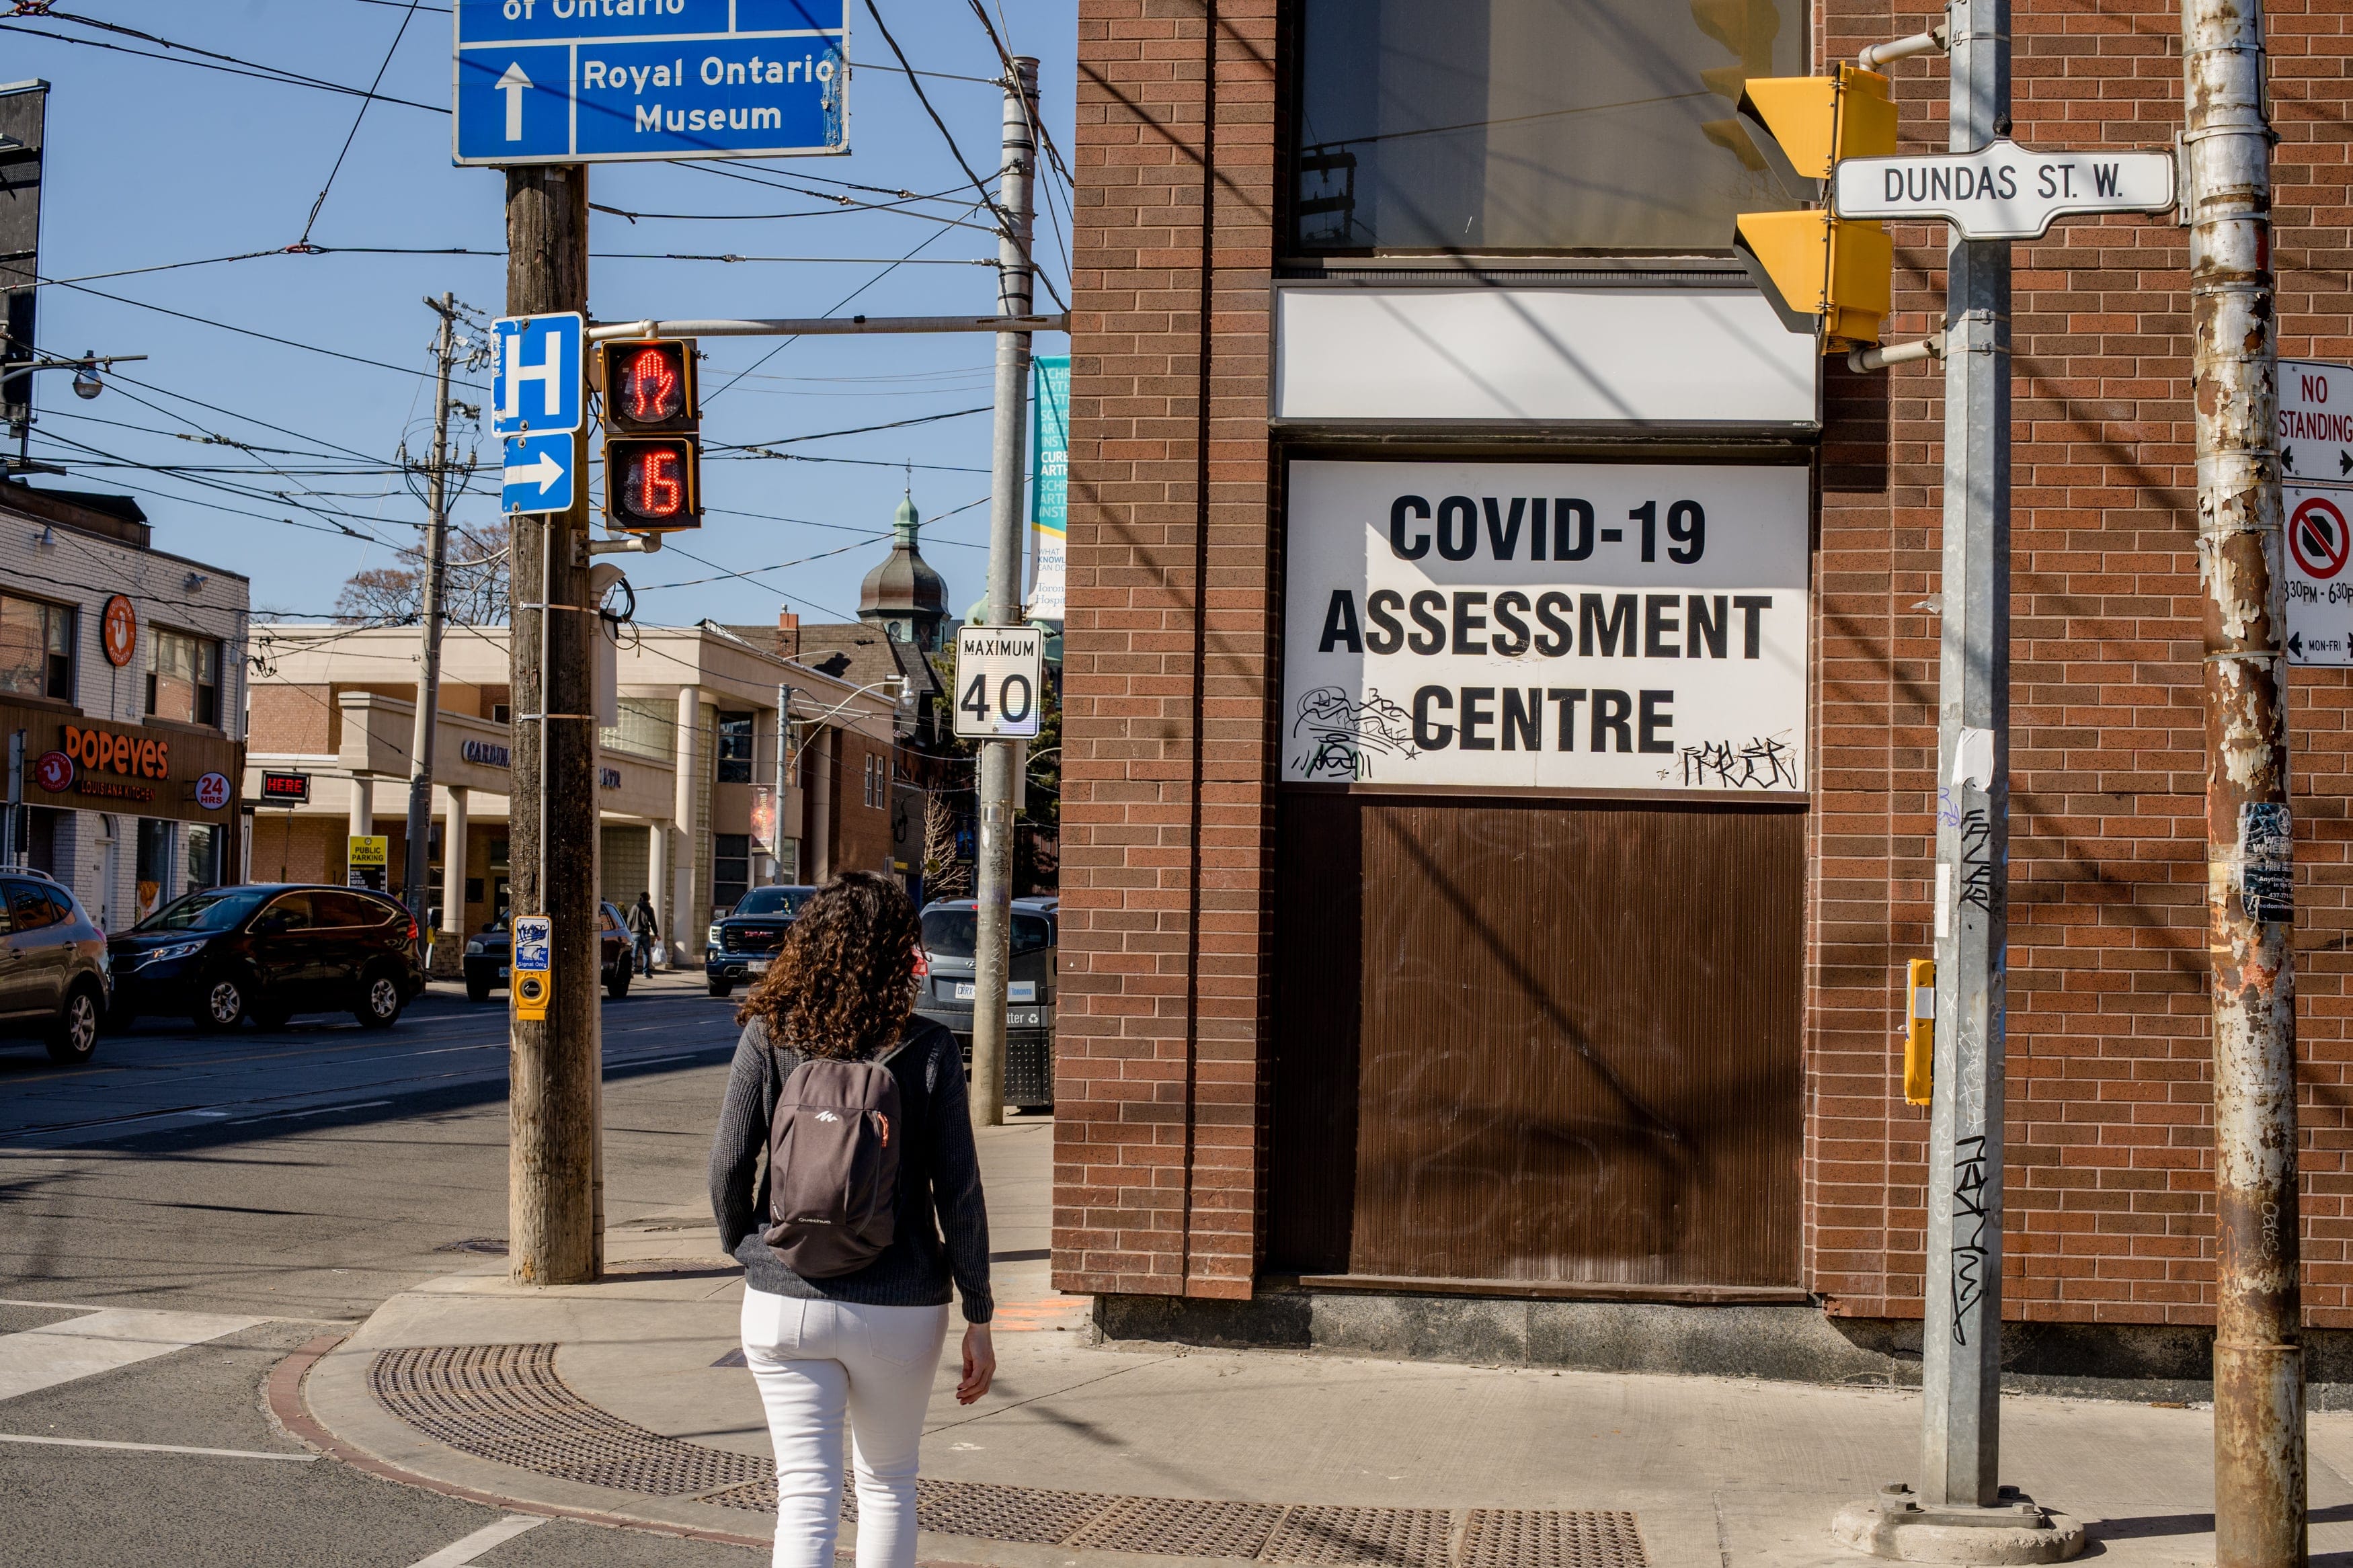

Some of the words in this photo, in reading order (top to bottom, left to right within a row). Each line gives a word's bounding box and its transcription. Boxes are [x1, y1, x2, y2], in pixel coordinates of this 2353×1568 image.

[553, 0, 684, 19] Ontario
[584, 58, 682, 94] Royal
[701, 55, 834, 85] Ontario
[635, 104, 781, 132] Museum
[1884, 165, 2017, 202] DUNDAS
[2038, 163, 2078, 199] ST.
[2093, 163, 2123, 198] W.
[505, 331, 561, 418] H
[2302, 374, 2327, 403] NO
[2279, 409, 2353, 443] STANDING
[645, 452, 678, 514] 15
[1390, 495, 1706, 565] COVID-19
[1318, 589, 1773, 660] ASSESSMENT
[110, 645, 130, 663] KITCHEN
[964, 639, 1034, 656] MAXIMUM
[2309, 639, 2342, 651] MON-FRI
[960, 673, 1032, 723] 40
[1412, 684, 1675, 753] CENTRE
[40, 754, 67, 766] LOUISIANA
[464, 741, 510, 768] CARDIN
[42, 780, 65, 790] KITCHEN
[81, 780, 122, 796] LOUISIANA
[124, 784, 156, 801] KITCHEN
[202, 776, 223, 795] 24
[267, 778, 303, 792] HERE
[200, 796, 223, 804] HRS
